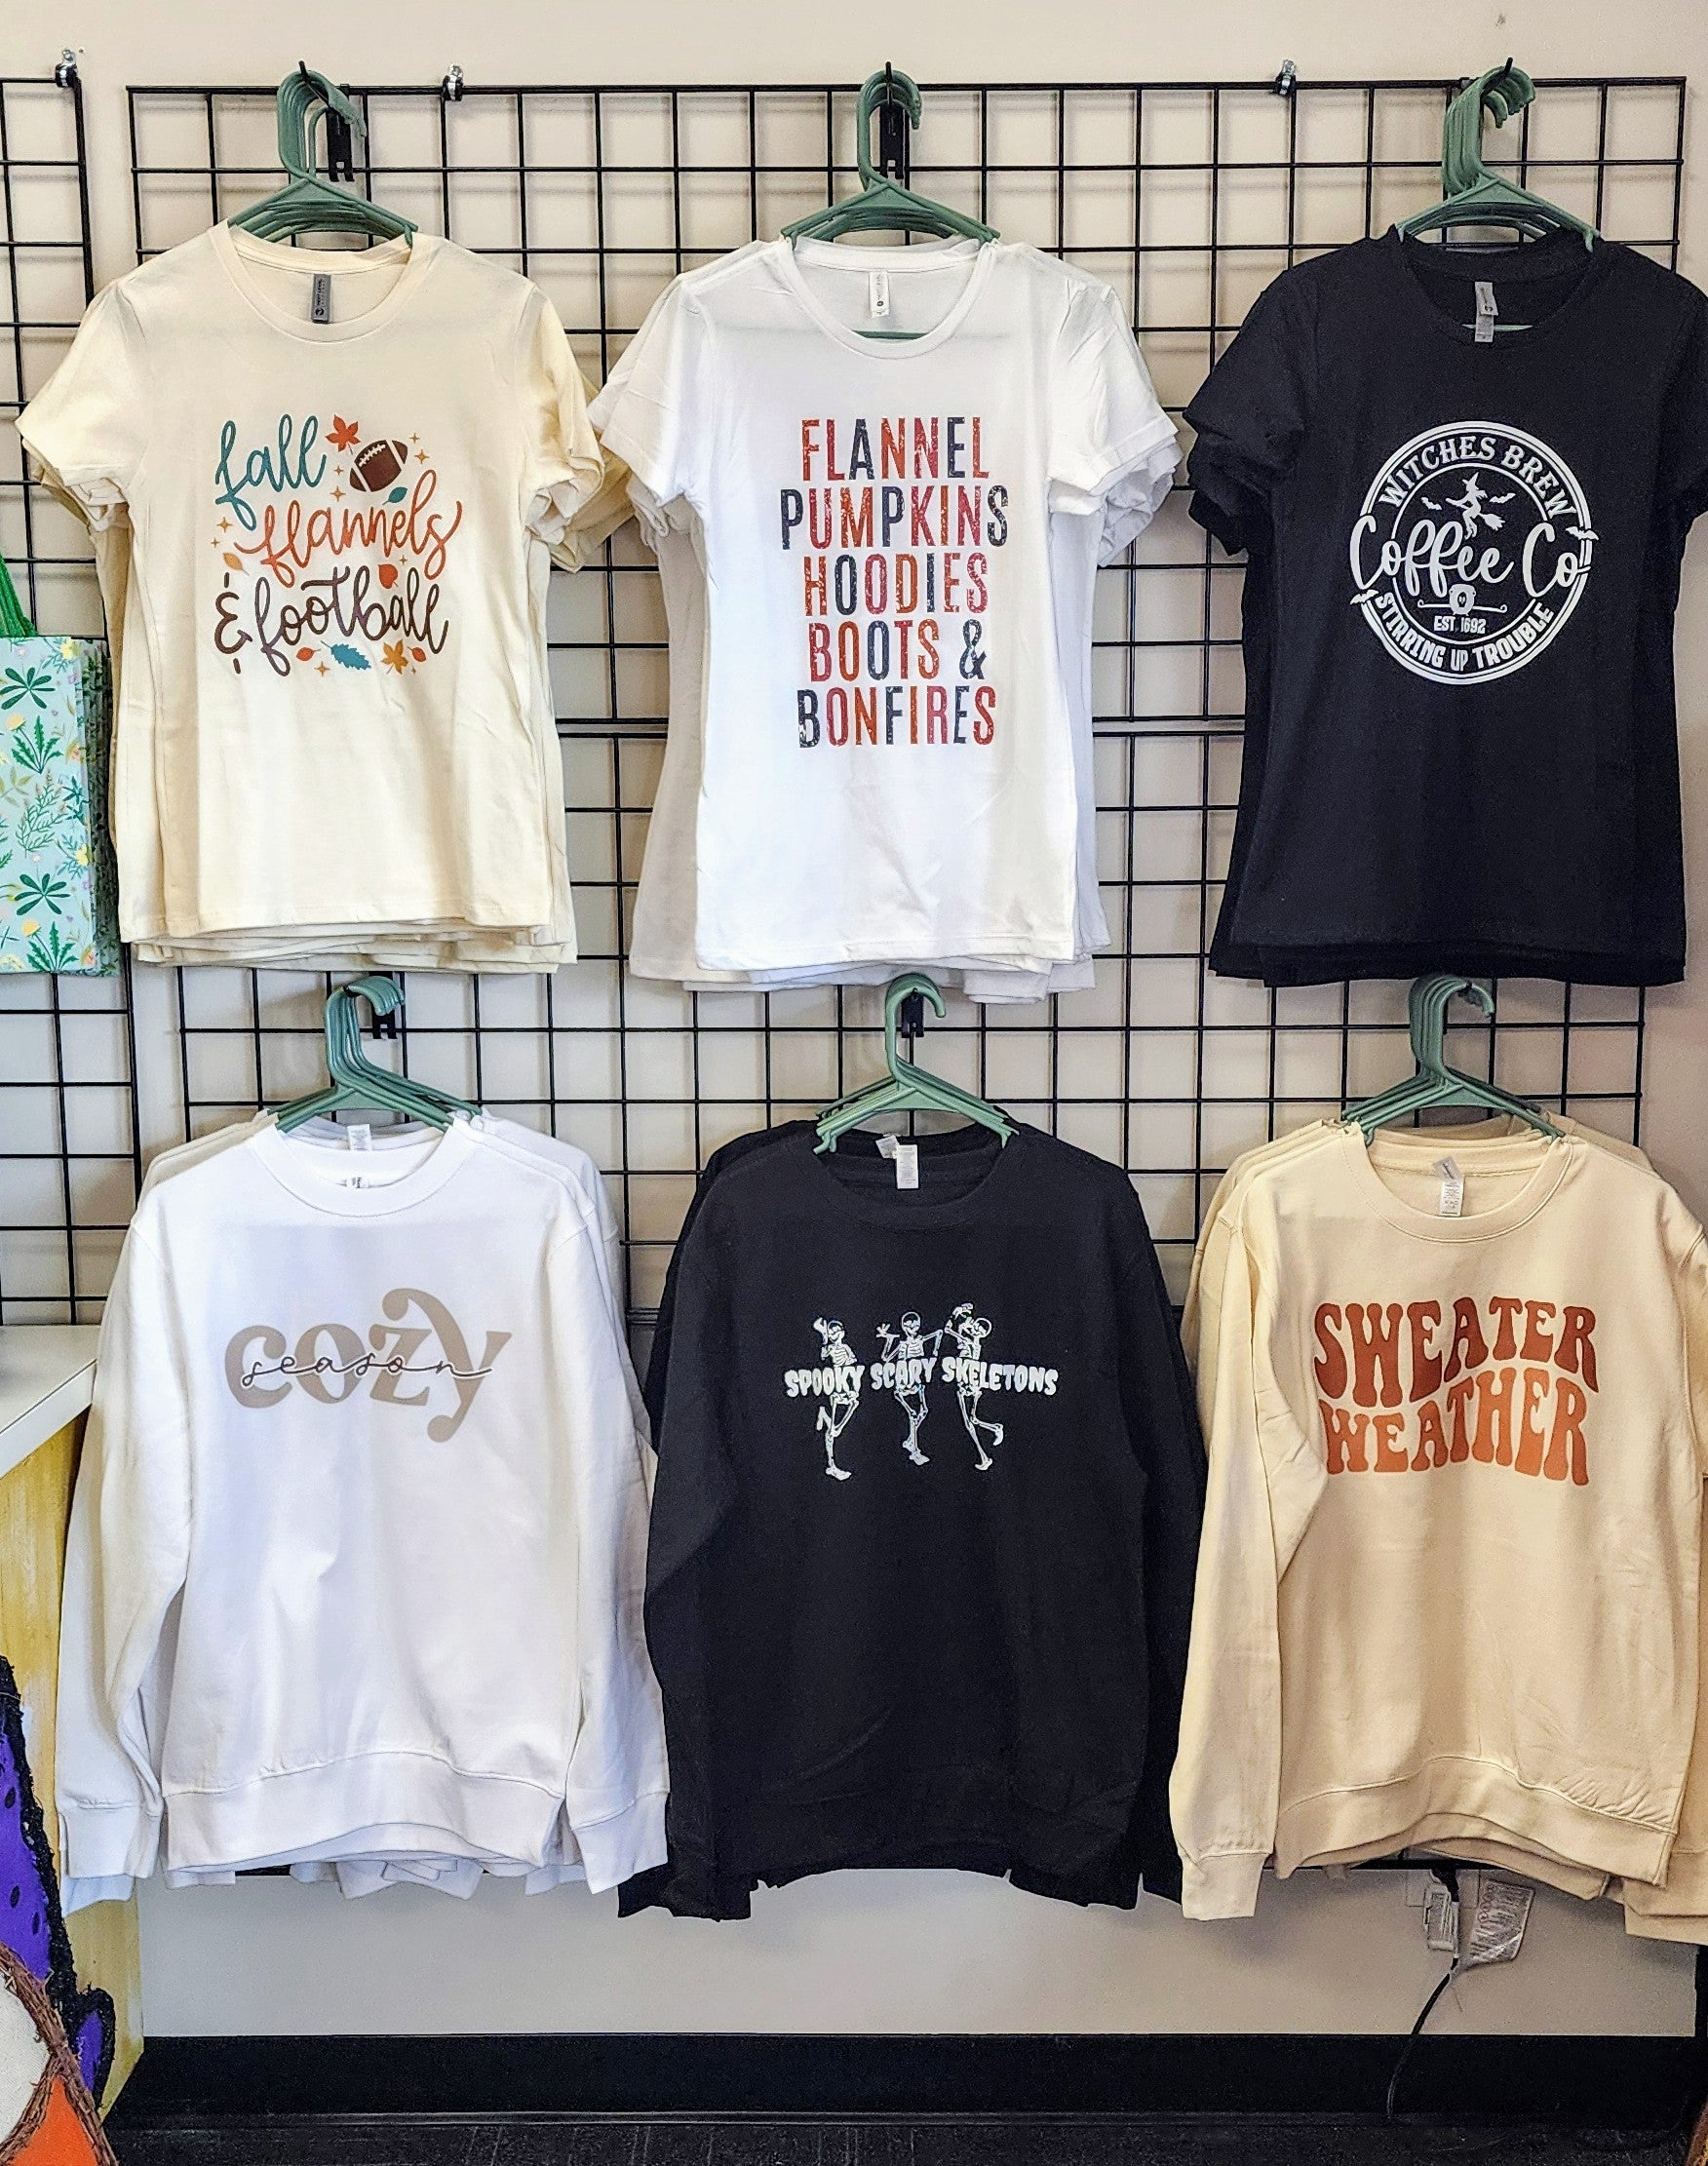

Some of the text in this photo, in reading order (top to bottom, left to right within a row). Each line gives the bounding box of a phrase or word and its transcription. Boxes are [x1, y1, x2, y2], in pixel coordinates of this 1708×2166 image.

[215, 414, 327, 531] fall
[801, 416, 990, 482] FLANNEL
[1378, 436, 1576, 519] WITCHES BREW
[234, 469, 463, 588] flannels
[780, 484, 1009, 550] PUMPKINS
[1350, 515, 1592, 598] Coffee Co
[254, 565, 448, 677] football
[803, 552, 989, 616] HOODIES
[808, 619, 987, 682] BOOTS &
[1377, 592, 1555, 672] STIRRING UP TROUBLE
[1461, 616, 1487, 634] 1692
[796, 685, 996, 749] BONFIRES
[224, 1288, 513, 1443] cozy
[242, 1353, 492, 1388] season
[784, 1356, 1059, 1398] SPOOKY SCARY SKELETONS
[1314, 1296, 1599, 1408] SWEATER
[1318, 1367, 1589, 1487] WEATHER
